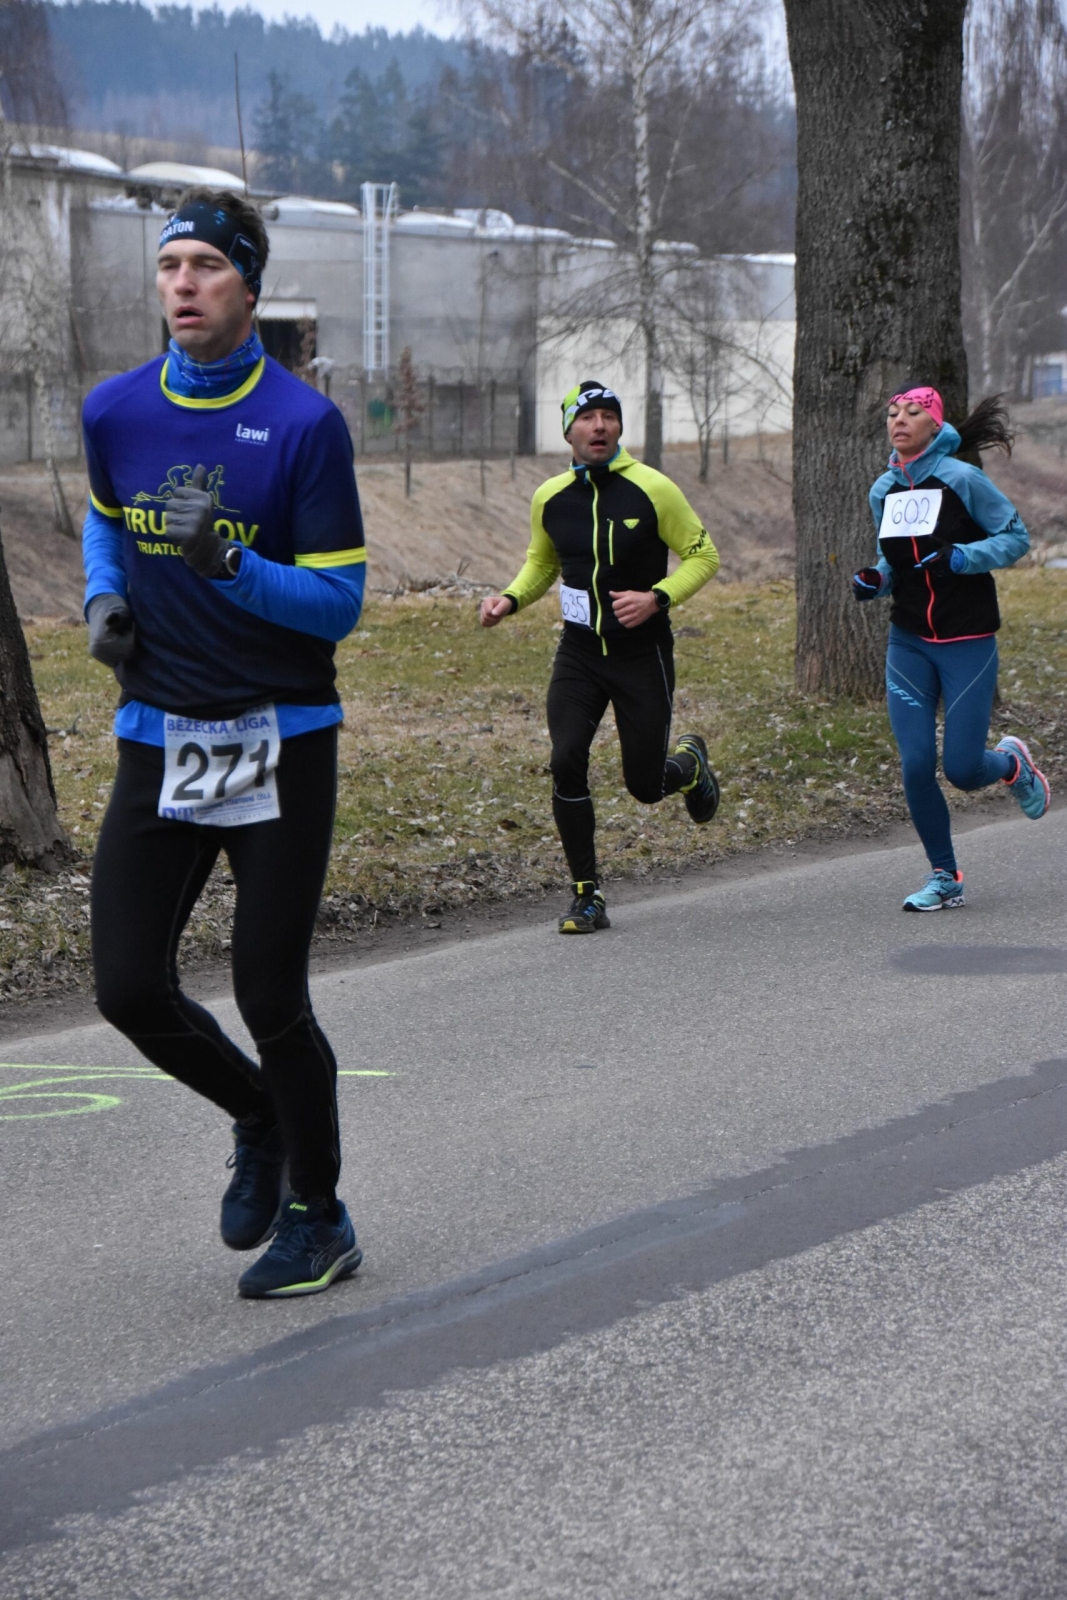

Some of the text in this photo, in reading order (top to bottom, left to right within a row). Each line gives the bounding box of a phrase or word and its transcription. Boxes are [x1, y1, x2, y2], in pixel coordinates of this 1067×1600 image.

[236, 423, 269, 442] lawi
[891, 497, 930, 525] 602
[123, 507, 258, 546] TRUOV
[560, 590, 588, 623] 635
[235, 716, 271, 732] LIGA
[171, 739, 270, 801] 271
